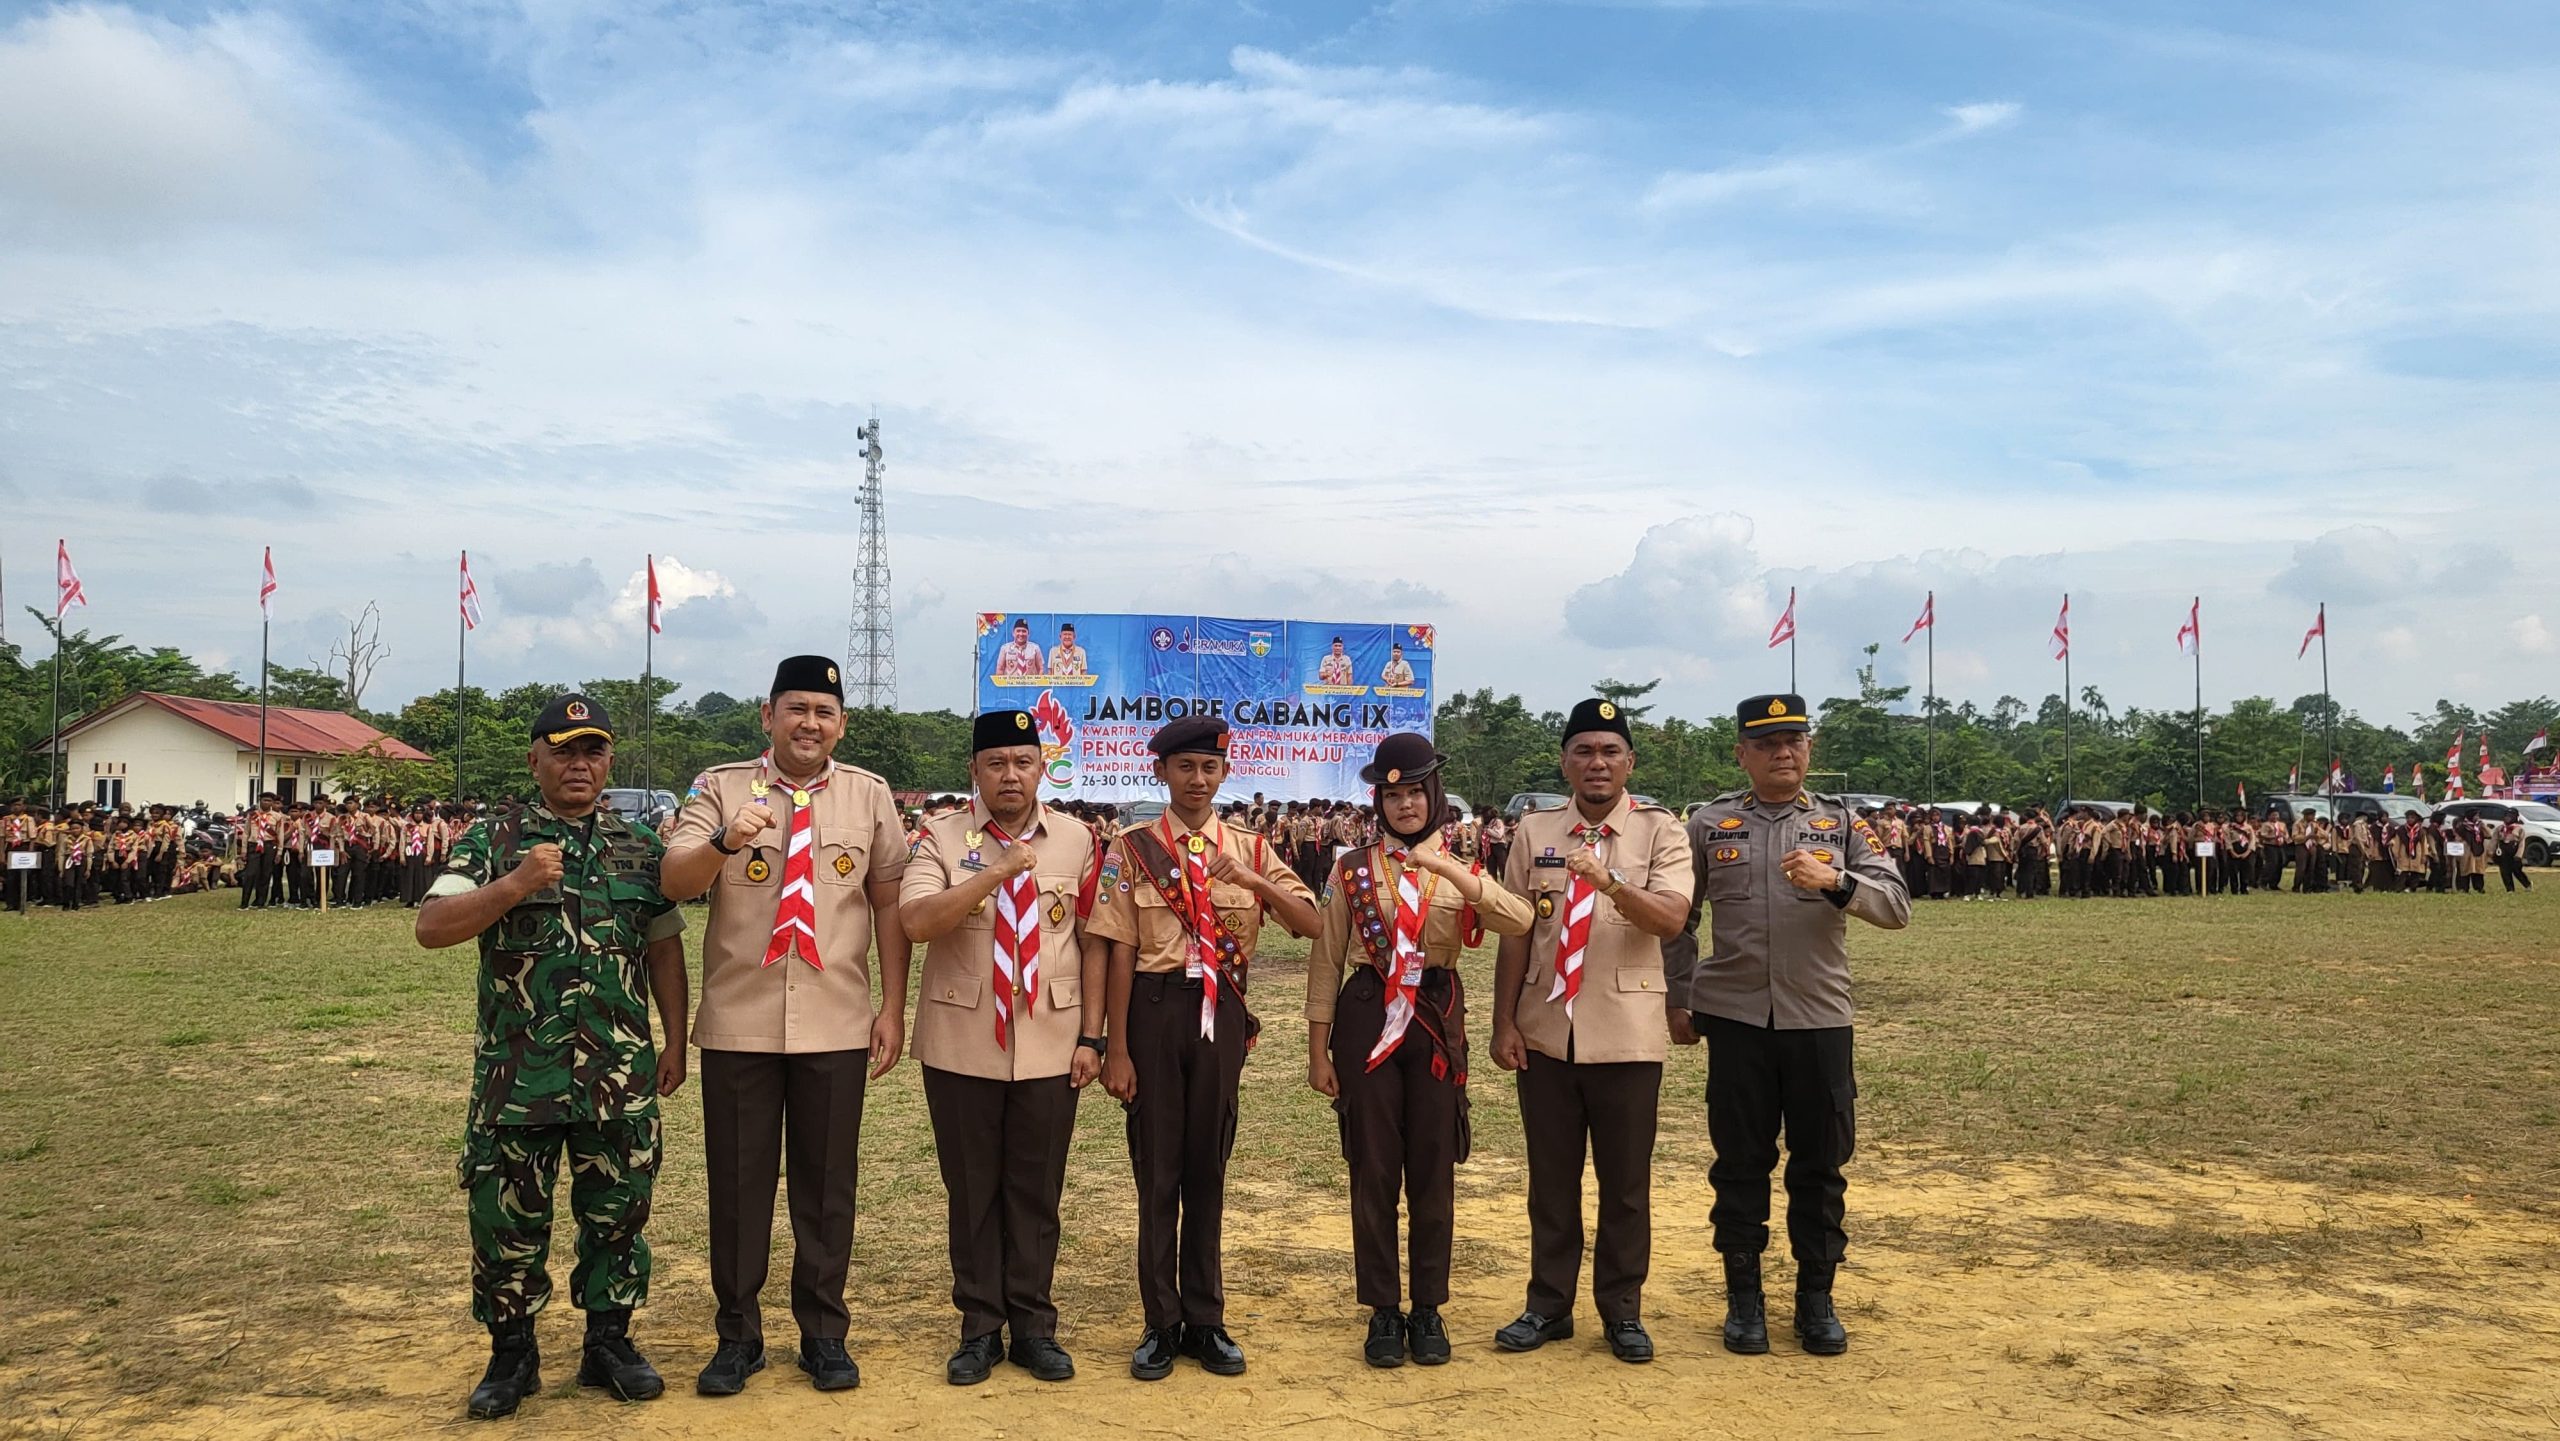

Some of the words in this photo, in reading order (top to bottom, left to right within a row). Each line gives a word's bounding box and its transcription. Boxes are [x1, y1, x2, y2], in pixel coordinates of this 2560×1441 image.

[1193, 639, 1245, 653] PRAMUKA
[1083, 696, 1224, 721] JAMBORE
[1234, 701, 1351, 728] CABANG
[1362, 704, 1389, 729] IX
[1082, 726, 1136, 737] KWARTIR
[1230, 744, 1283, 761] ERANI
[1291, 747, 1342, 762] MAJU
[1082, 763, 1133, 773] (MANDIRI
[1240, 766, 1290, 777] UNGGUL)
[1082, 776, 1116, 786] 26-30
[1799, 831, 1843, 846] POLRI
[612, 860, 634, 871] TNI
[640, 861, 655, 873] AD
